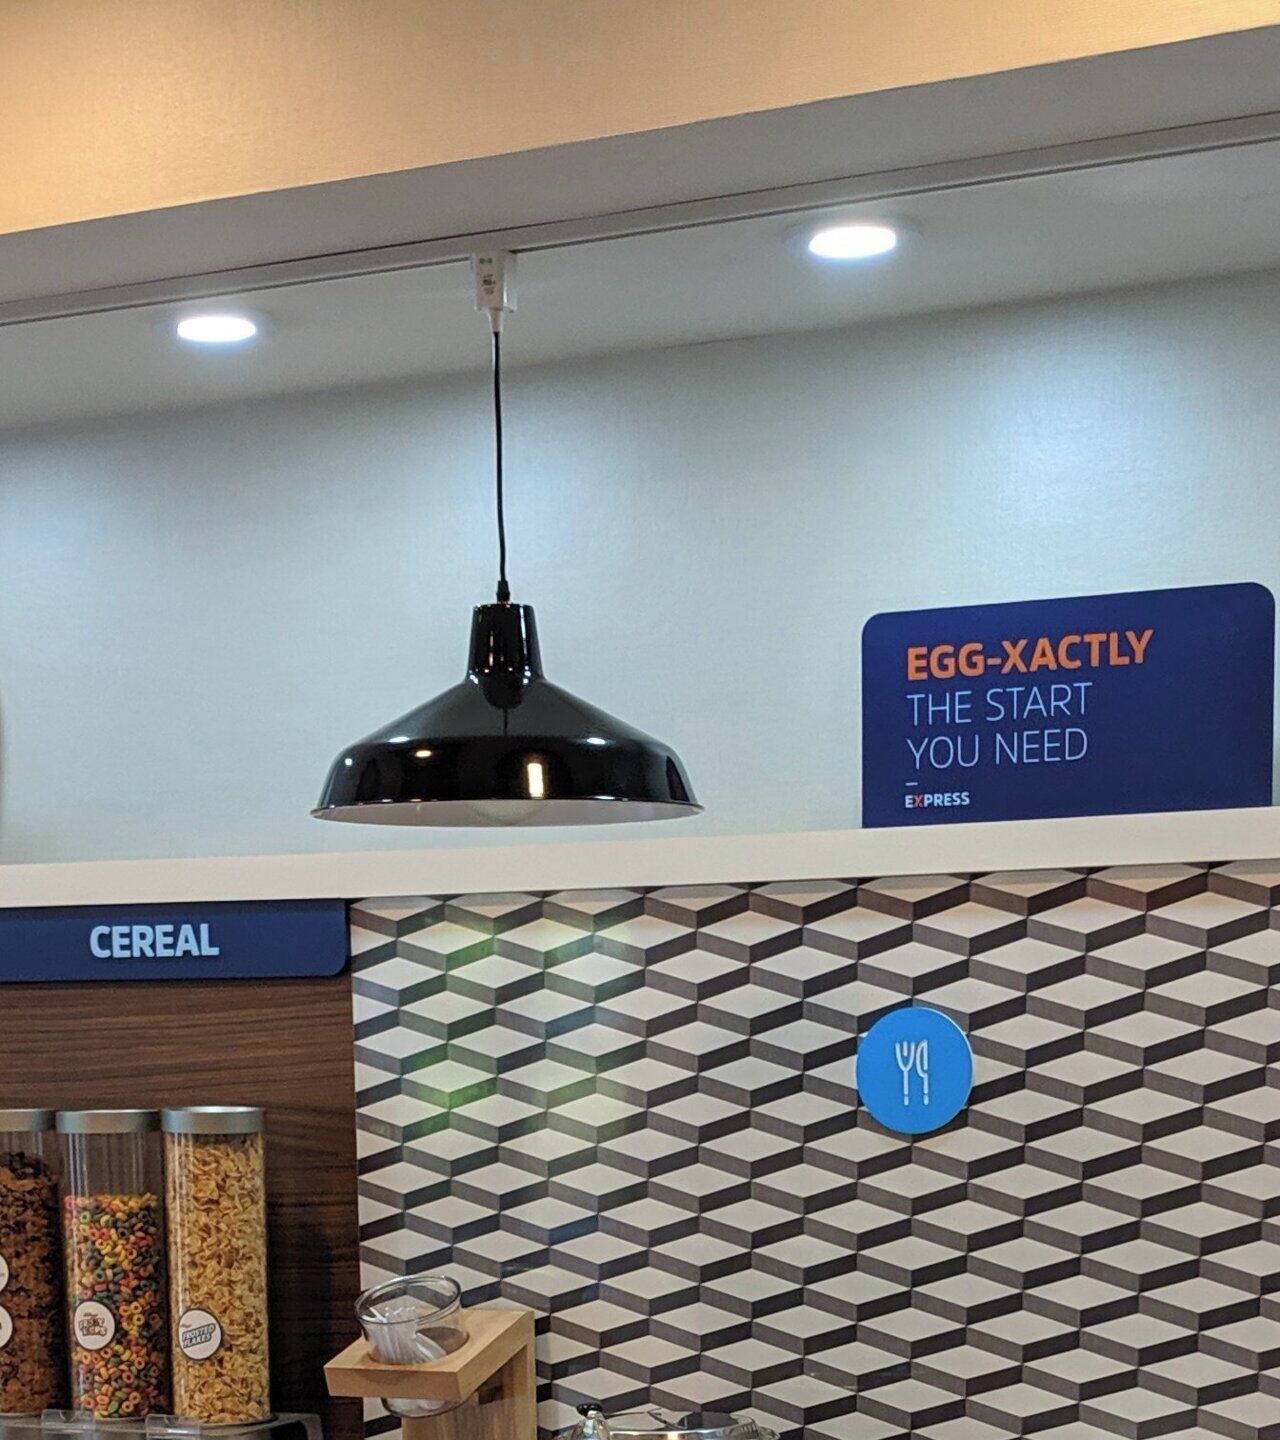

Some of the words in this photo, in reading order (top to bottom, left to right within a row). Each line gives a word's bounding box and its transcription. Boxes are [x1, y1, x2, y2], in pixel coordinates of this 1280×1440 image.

[905, 629, 1154, 681] EGG-XACTLY
[906, 690, 973, 727] THE
[986, 682, 1093, 722] START
[906, 734, 980, 770] YOU
[995, 728, 1089, 765] NEED
[904, 791, 970, 809] EXPRESS
[88, 922, 220, 959] CEREAL
